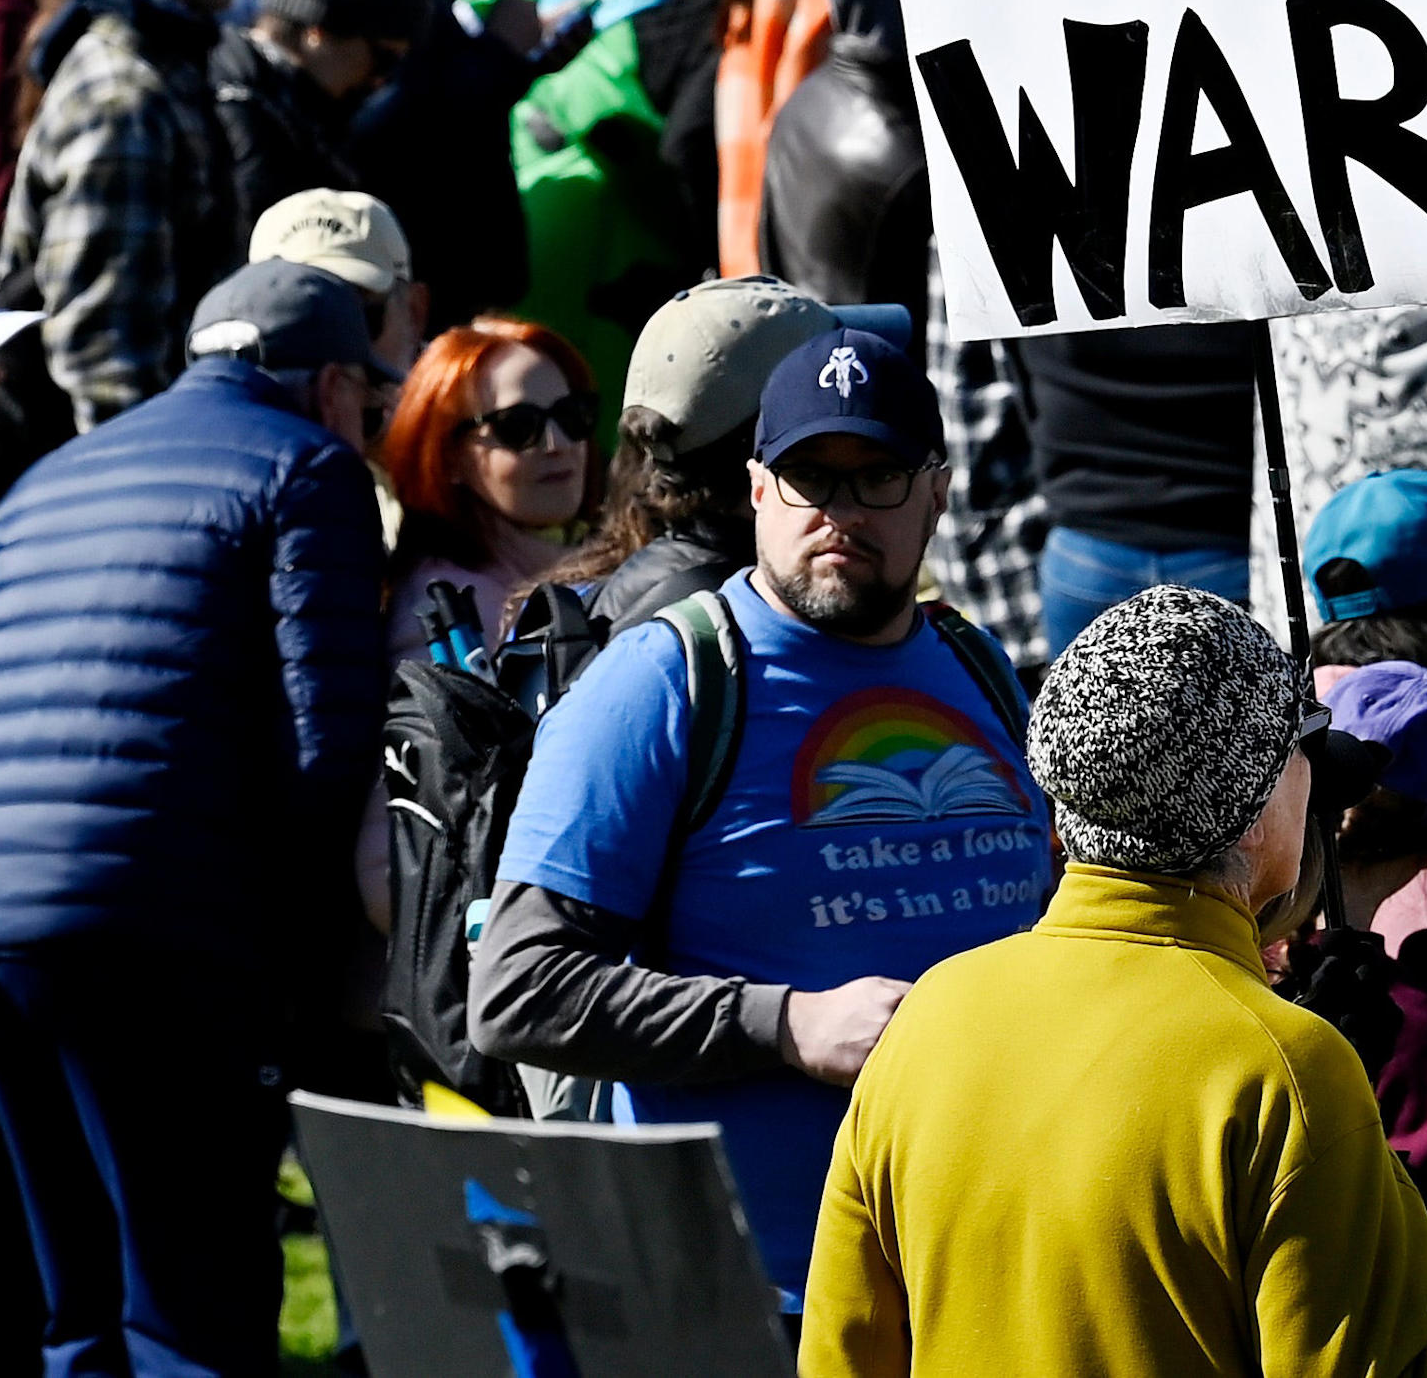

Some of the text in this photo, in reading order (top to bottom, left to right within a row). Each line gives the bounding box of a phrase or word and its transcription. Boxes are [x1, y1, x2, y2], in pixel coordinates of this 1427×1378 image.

[819, 822, 1033, 871] take a look
[810, 891, 888, 928] it's
[895, 887, 944, 918] in
[952, 887, 973, 911] a
